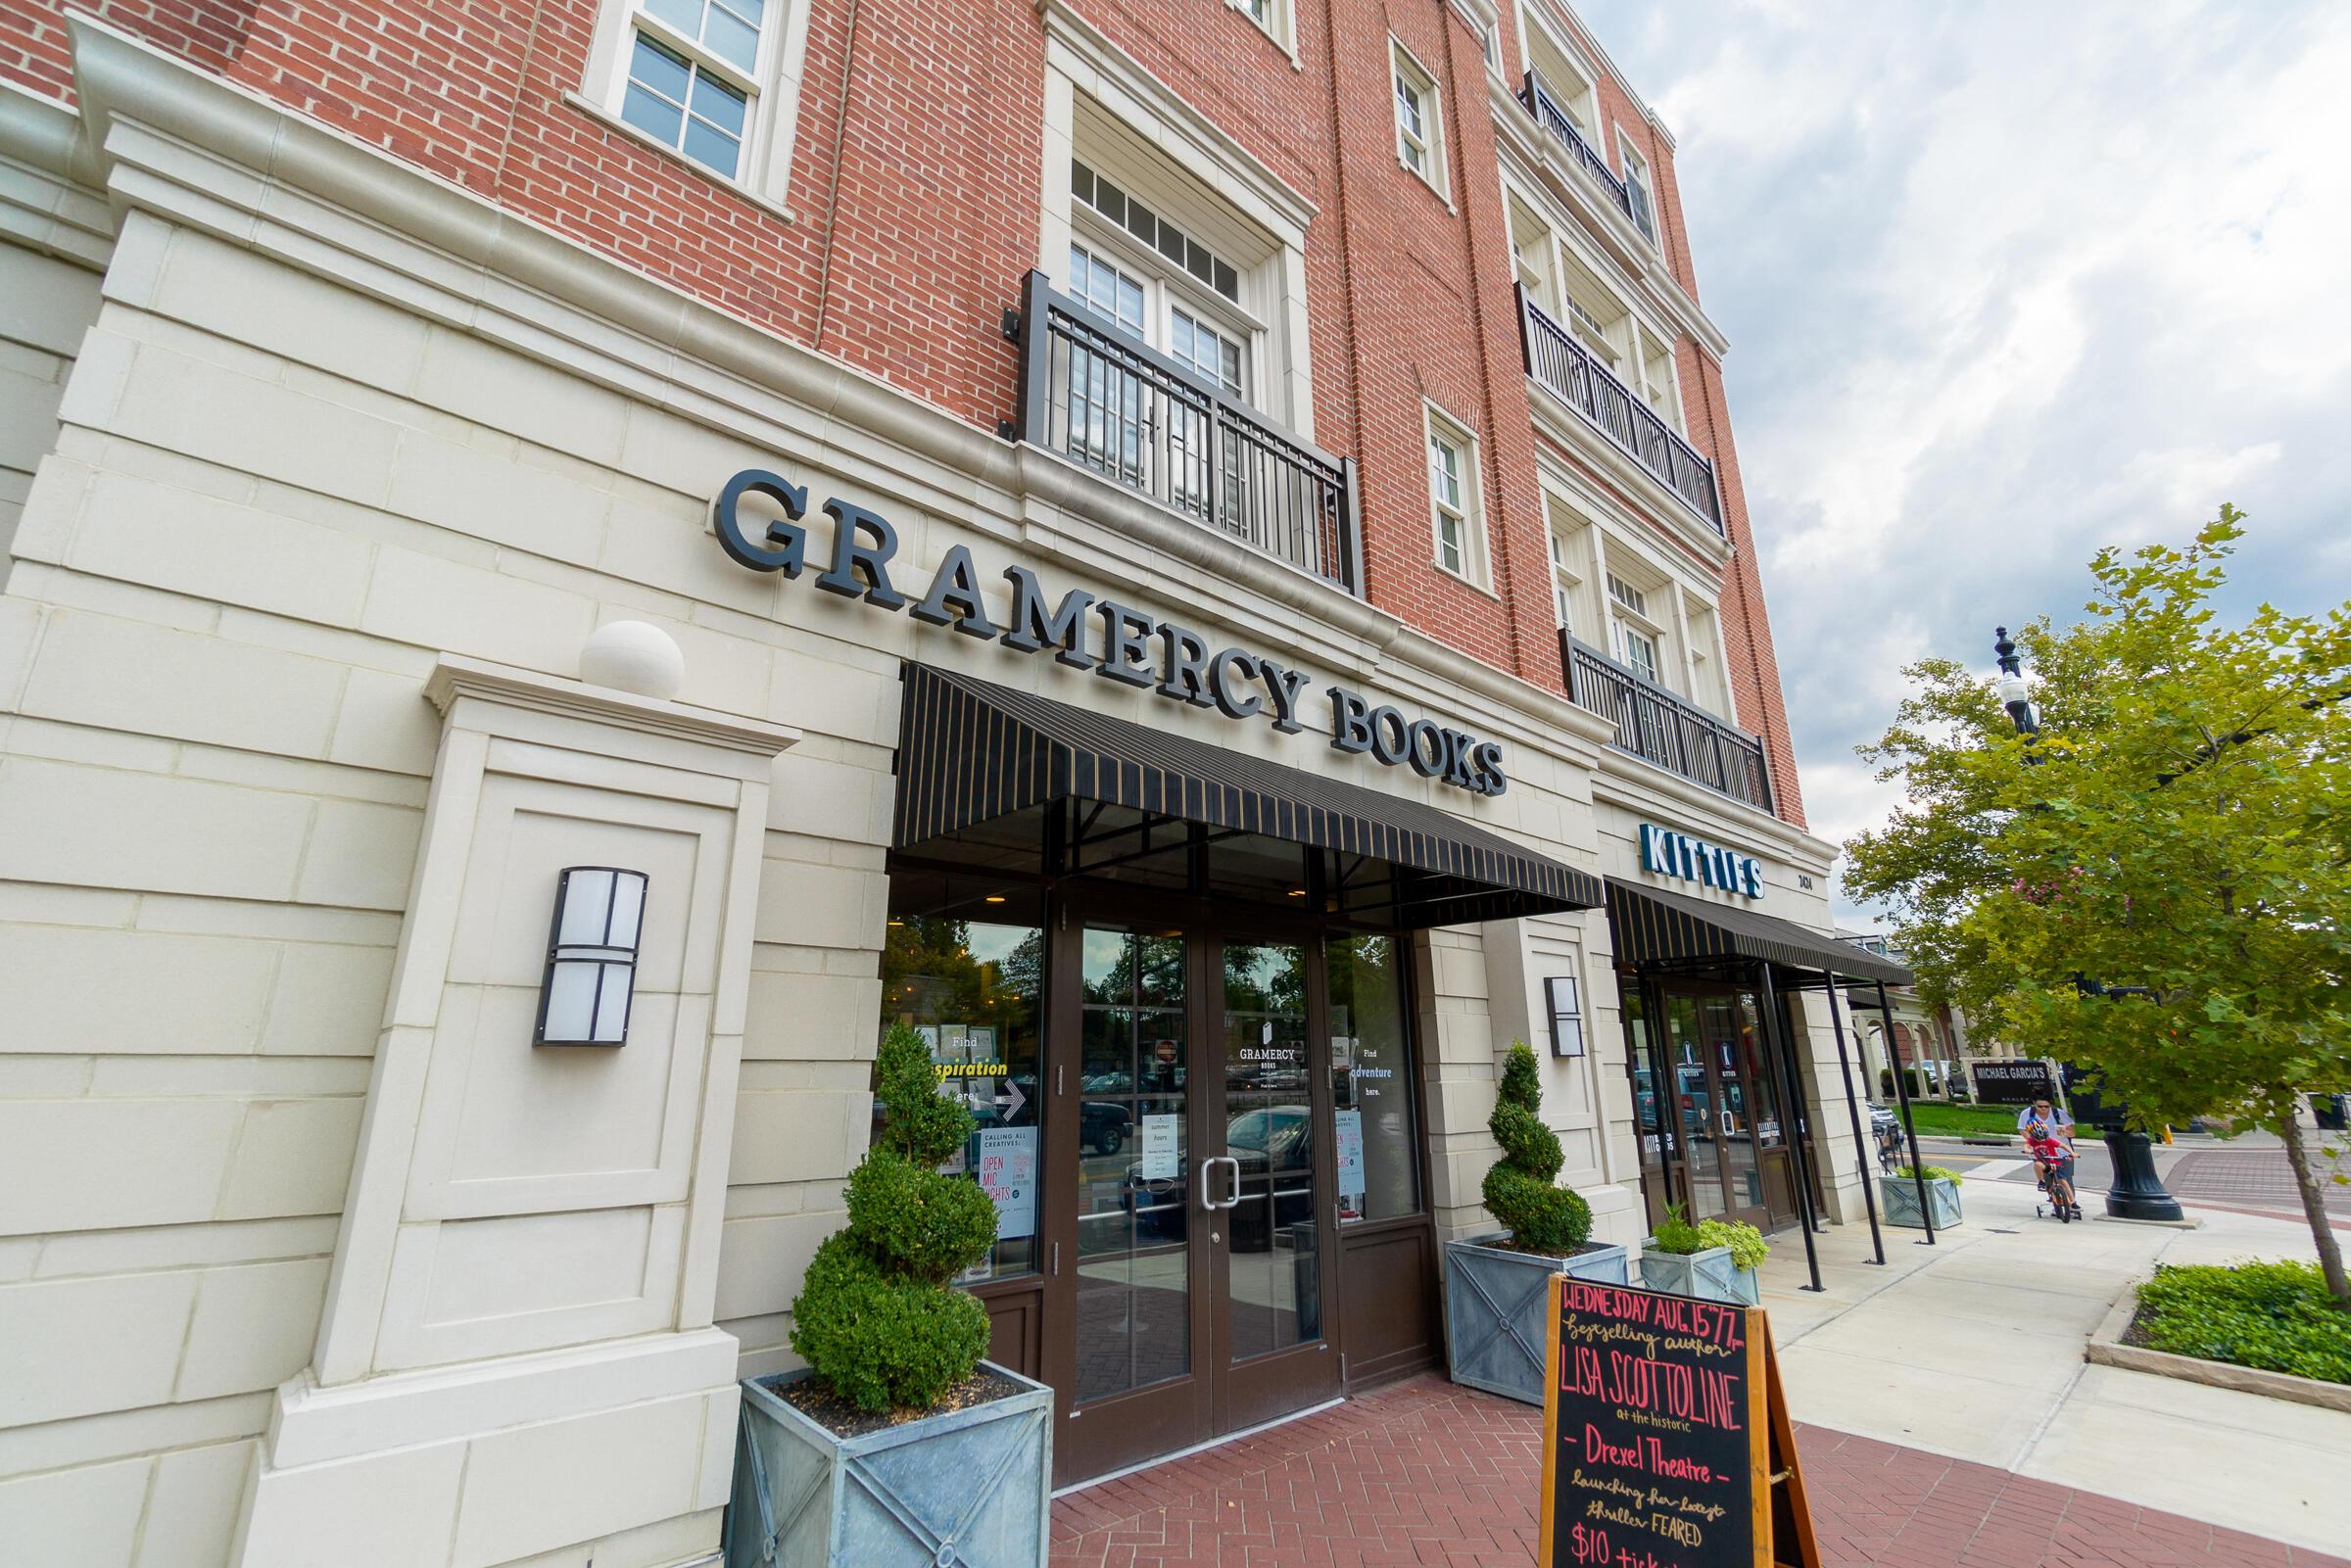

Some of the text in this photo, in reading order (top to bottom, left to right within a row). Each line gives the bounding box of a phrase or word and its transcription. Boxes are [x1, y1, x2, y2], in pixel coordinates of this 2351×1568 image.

[713, 469, 1508, 797] GRAMERCY BOOKS
[1639, 823, 1765, 900] KITTIES
[952, 1036, 978, 1047] Find
[1364, 1049, 1377, 1058] Find
[1239, 1049, 1295, 1060] GRAMERCY
[932, 1058, 1008, 1082] spiration
[1351, 1064, 1392, 1077] adventure
[1976, 1067, 2045, 1079] MICHAEL GARCIA'S
[1366, 1087, 1381, 1096] here.
[984, 1156, 1003, 1171] OPEN
[983, 1172, 997, 1186] MIC
[1563, 1284, 1651, 1322] WEDNESDAY
[1561, 1313, 1732, 1360] bestselling author
[1560, 1345, 1742, 1431] LISA SCOTTOLINE
[1616, 1409, 1692, 1433] at the historic
[1585, 1423, 1644, 1470] Drexel
[1647, 1437, 1710, 1484] Theatre
[1571, 1469, 1726, 1522] launching her latest
[1587, 1500, 1703, 1547] thriller FEARED
[1571, 1522, 1609, 1565] $10
